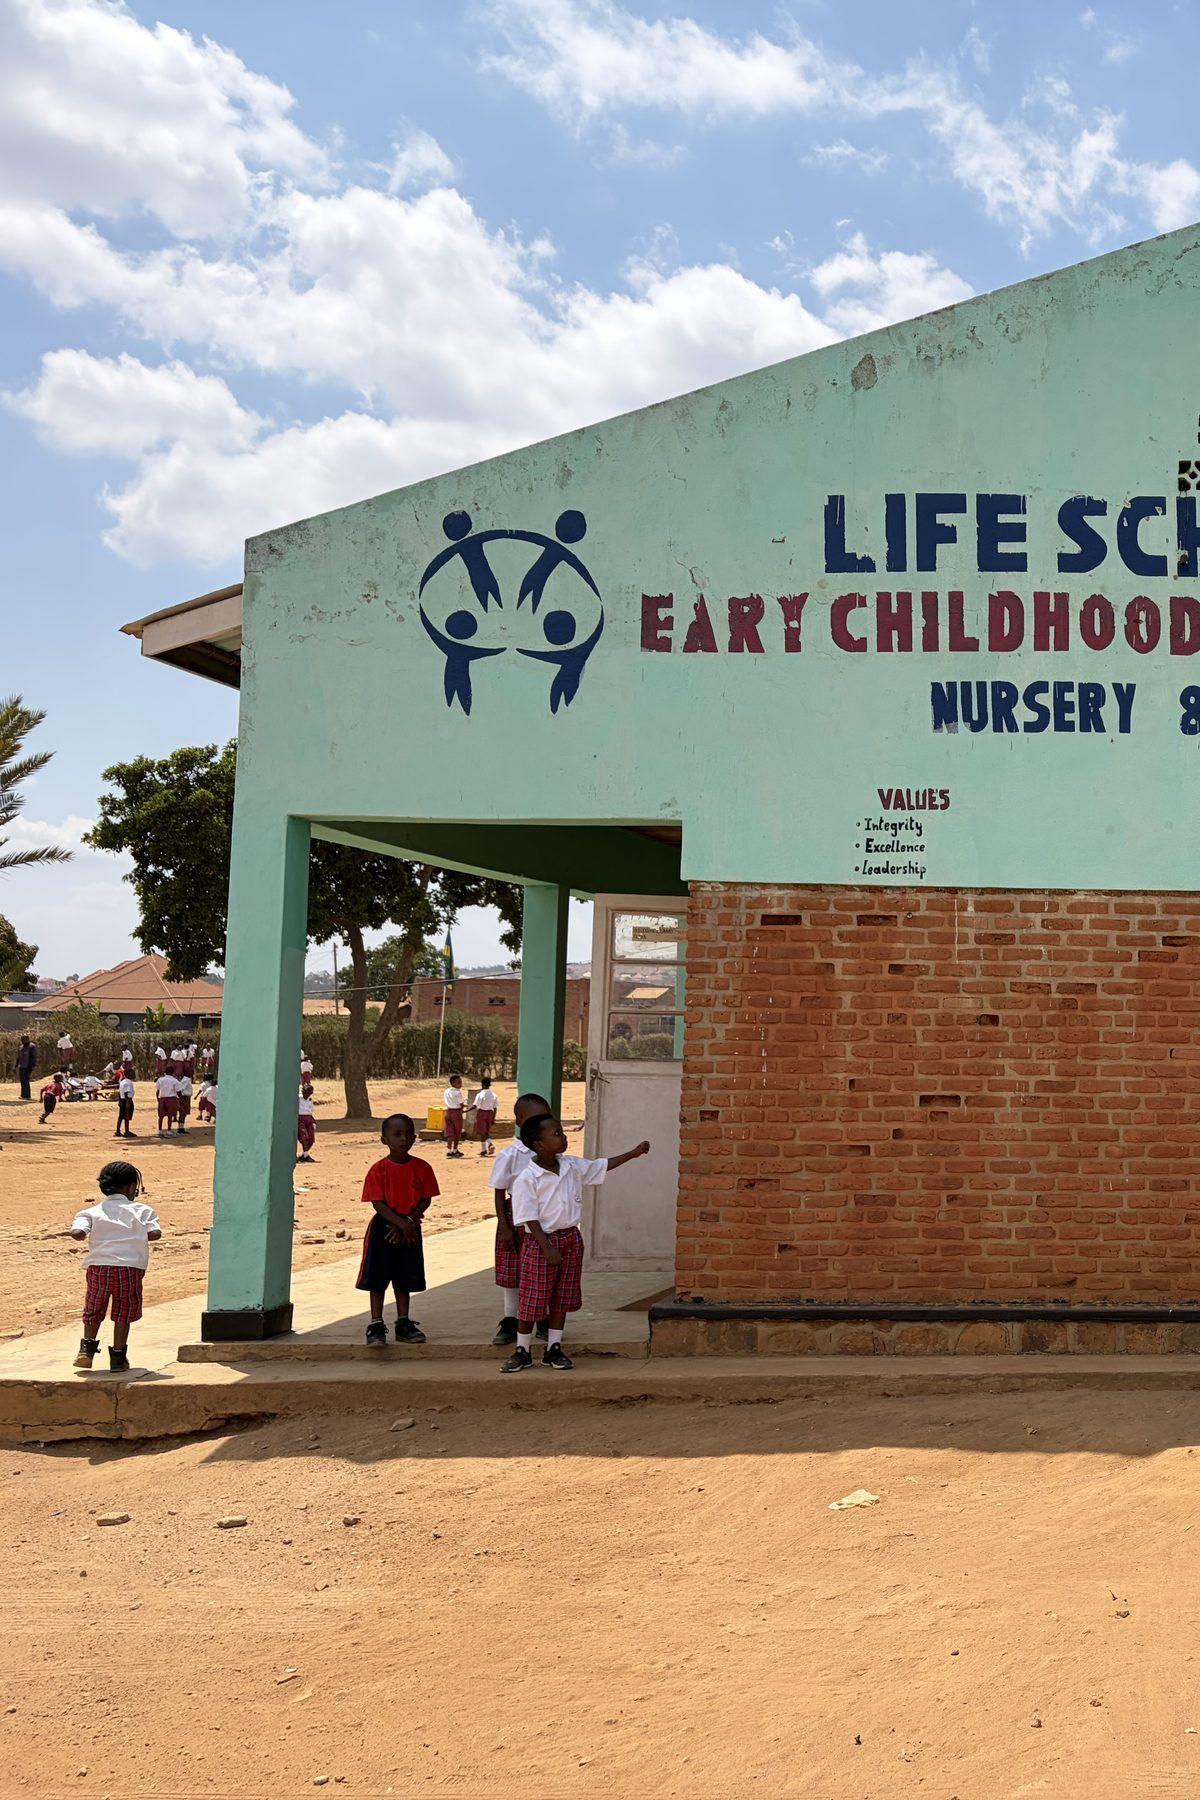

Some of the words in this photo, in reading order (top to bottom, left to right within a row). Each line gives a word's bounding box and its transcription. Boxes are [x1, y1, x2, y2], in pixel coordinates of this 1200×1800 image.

[824, 493, 1027, 573] LIFE
[641, 592, 809, 653] EARY
[931, 681, 1136, 733] NURSERY
[864, 816, 922, 837] Integrity
[865, 838, 925, 853] Excellence
[862, 860, 926, 879] Leadership
